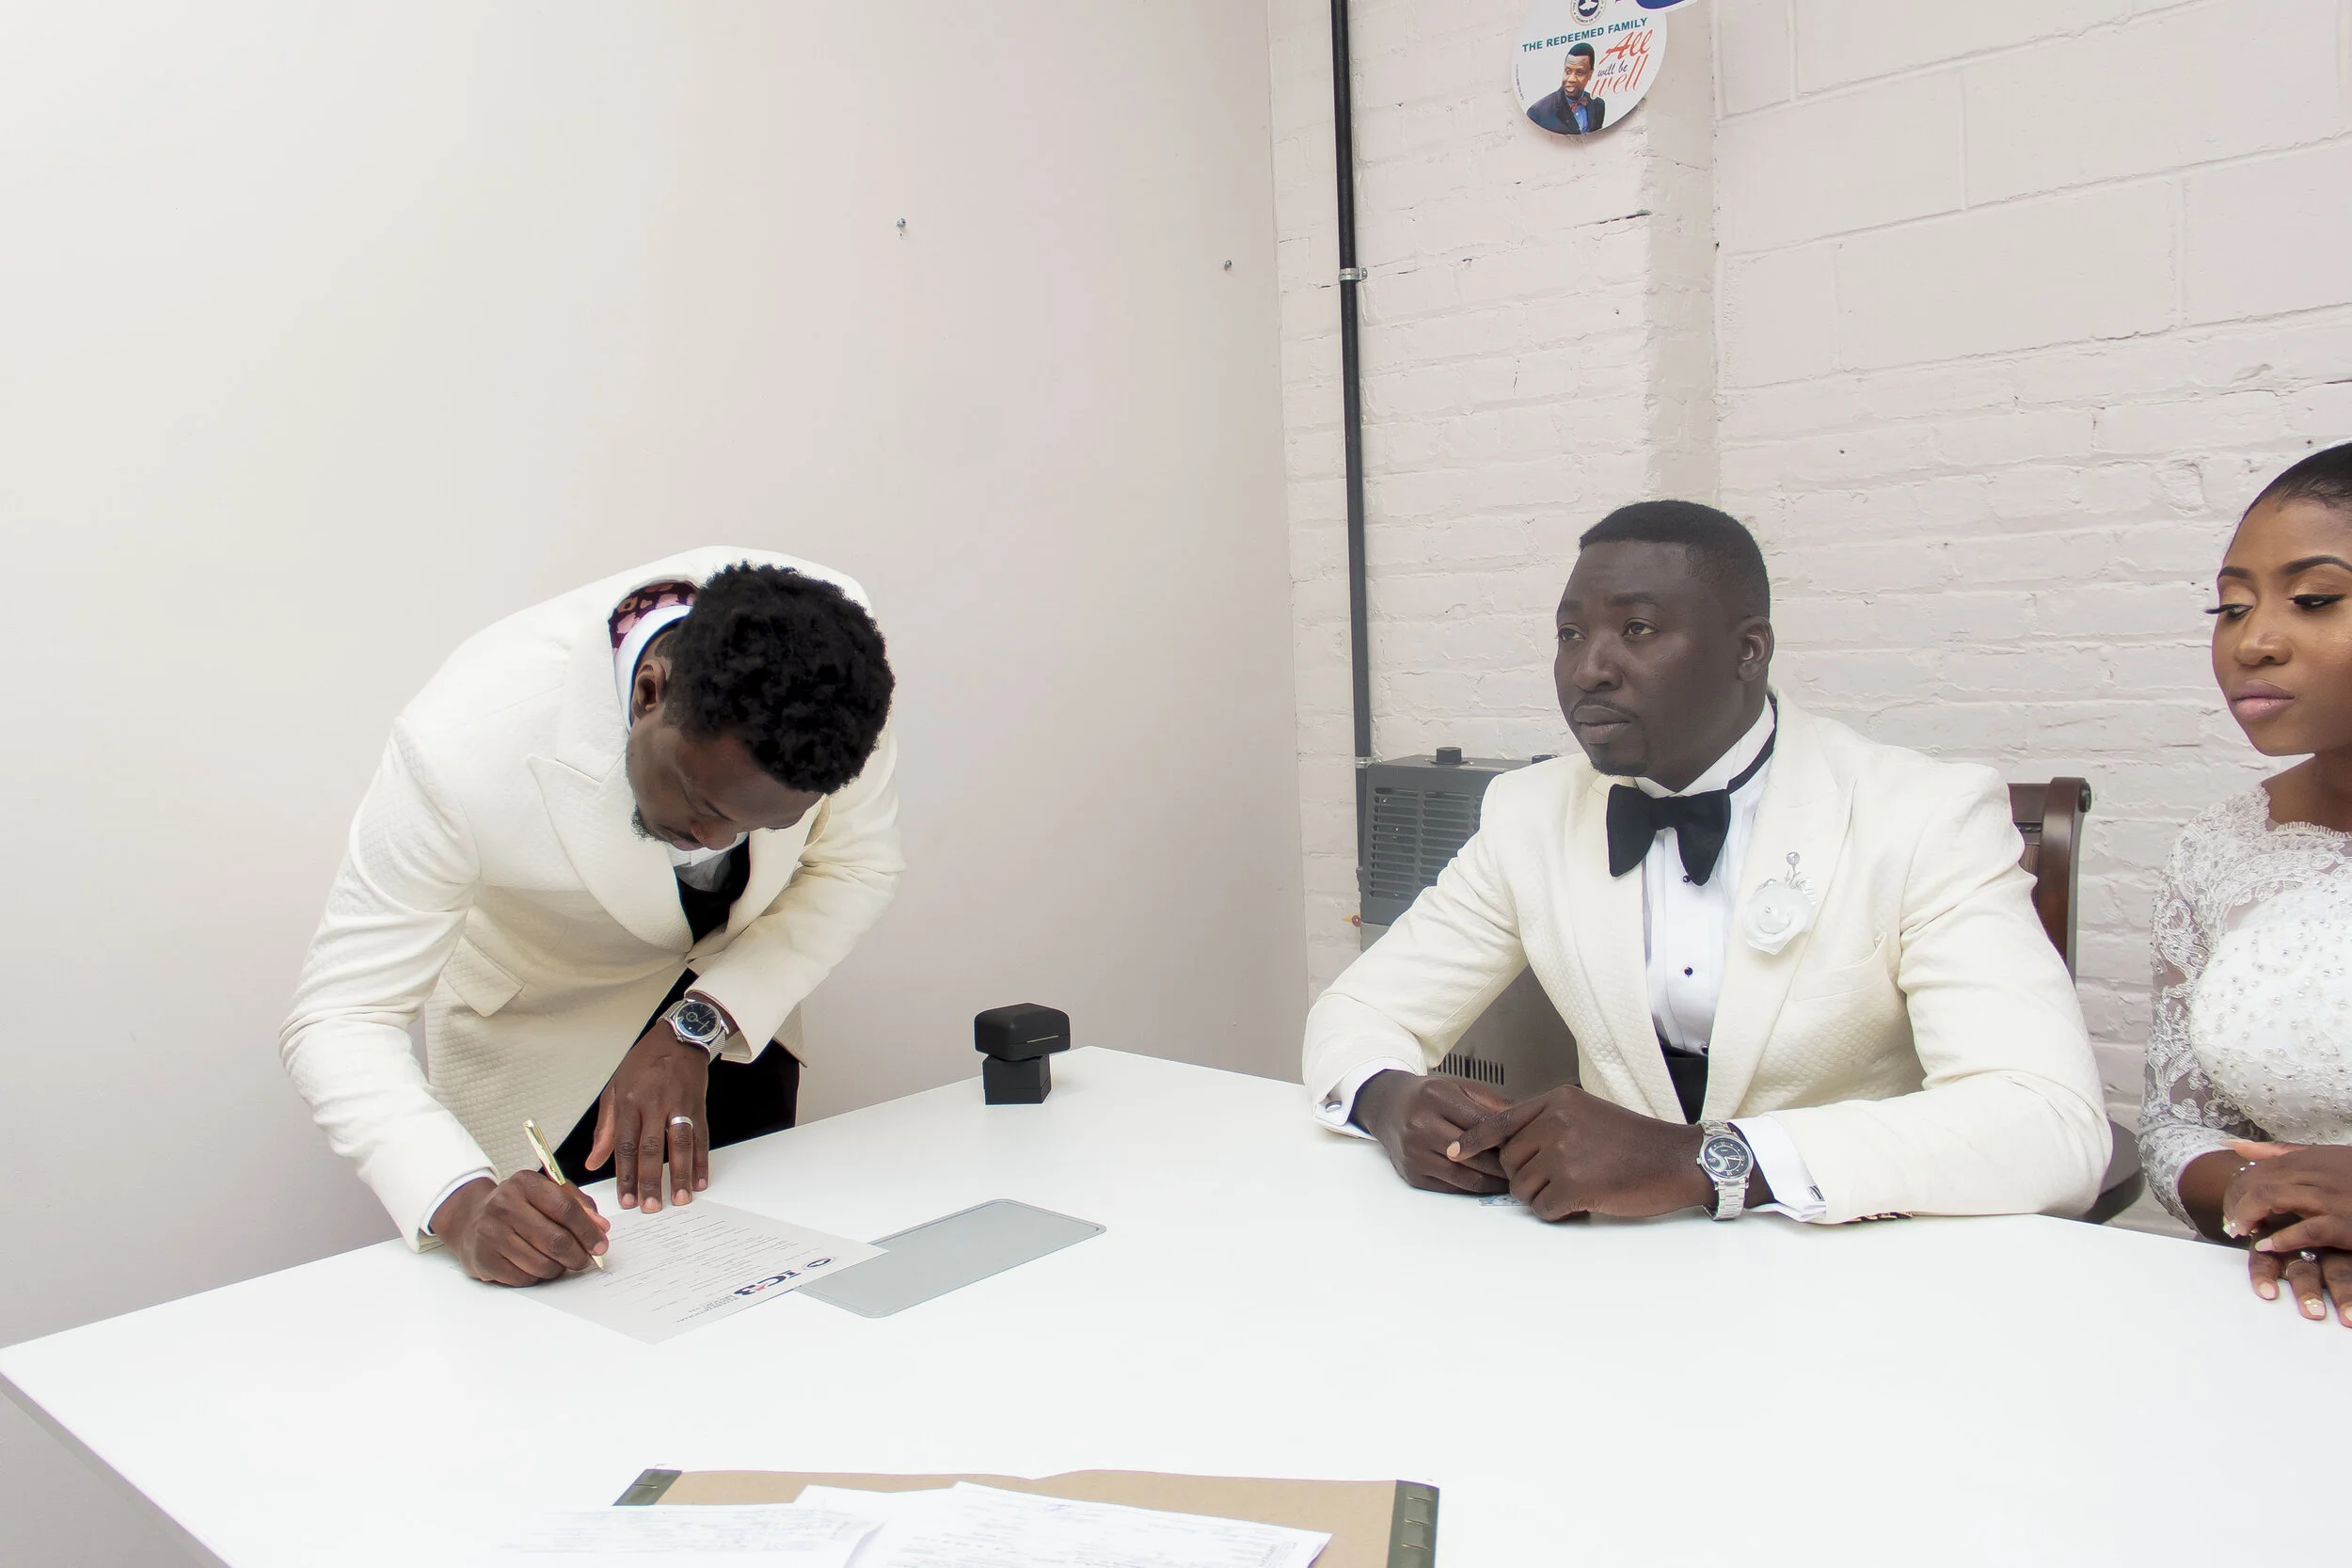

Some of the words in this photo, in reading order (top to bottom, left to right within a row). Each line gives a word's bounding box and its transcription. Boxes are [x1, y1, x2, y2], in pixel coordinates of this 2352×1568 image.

[1522, 40, 1543, 52] THE
[1546, 27, 1604, 47] REDEEMED
[1608, 17, 1647, 34] FAMILY
[1598, 29, 1653, 65] All
[1591, 54, 1649, 99] well
[1597, 62, 1616, 77] will
[1618, 59, 1628, 73] be
